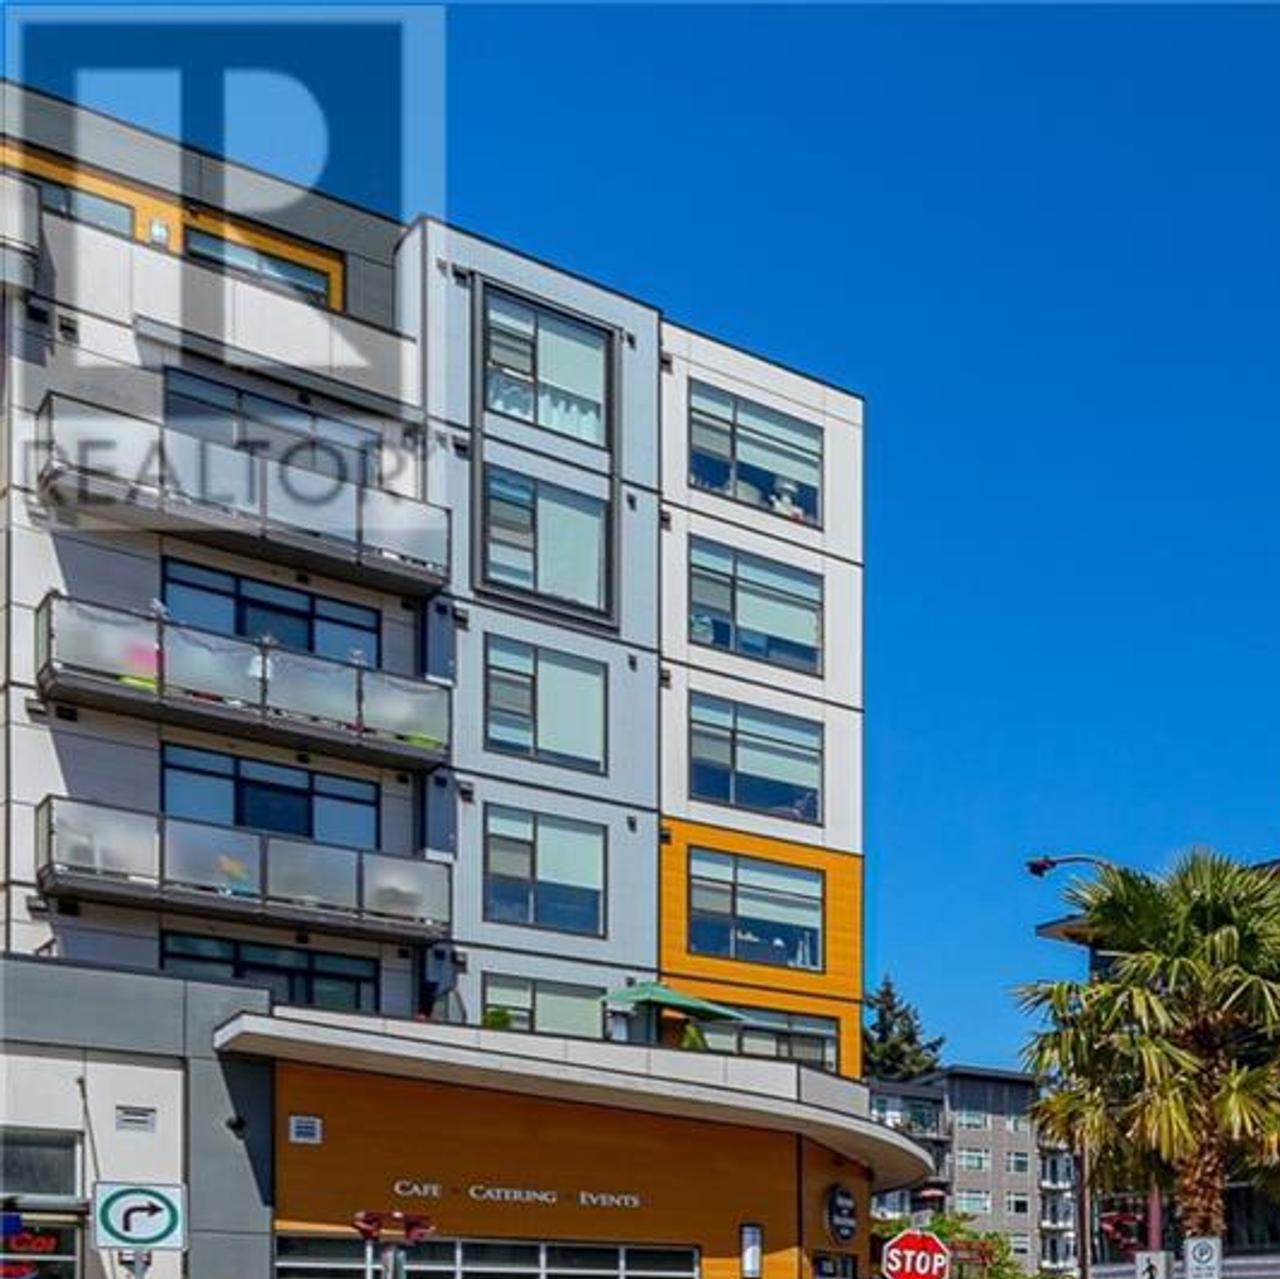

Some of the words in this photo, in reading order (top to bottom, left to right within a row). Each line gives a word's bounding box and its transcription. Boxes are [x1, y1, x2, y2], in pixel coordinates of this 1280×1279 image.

[468, 1185, 558, 1204] CATERING
[579, 1190, 641, 1208] EVENTS
[888, 1248, 945, 1275] STOP
